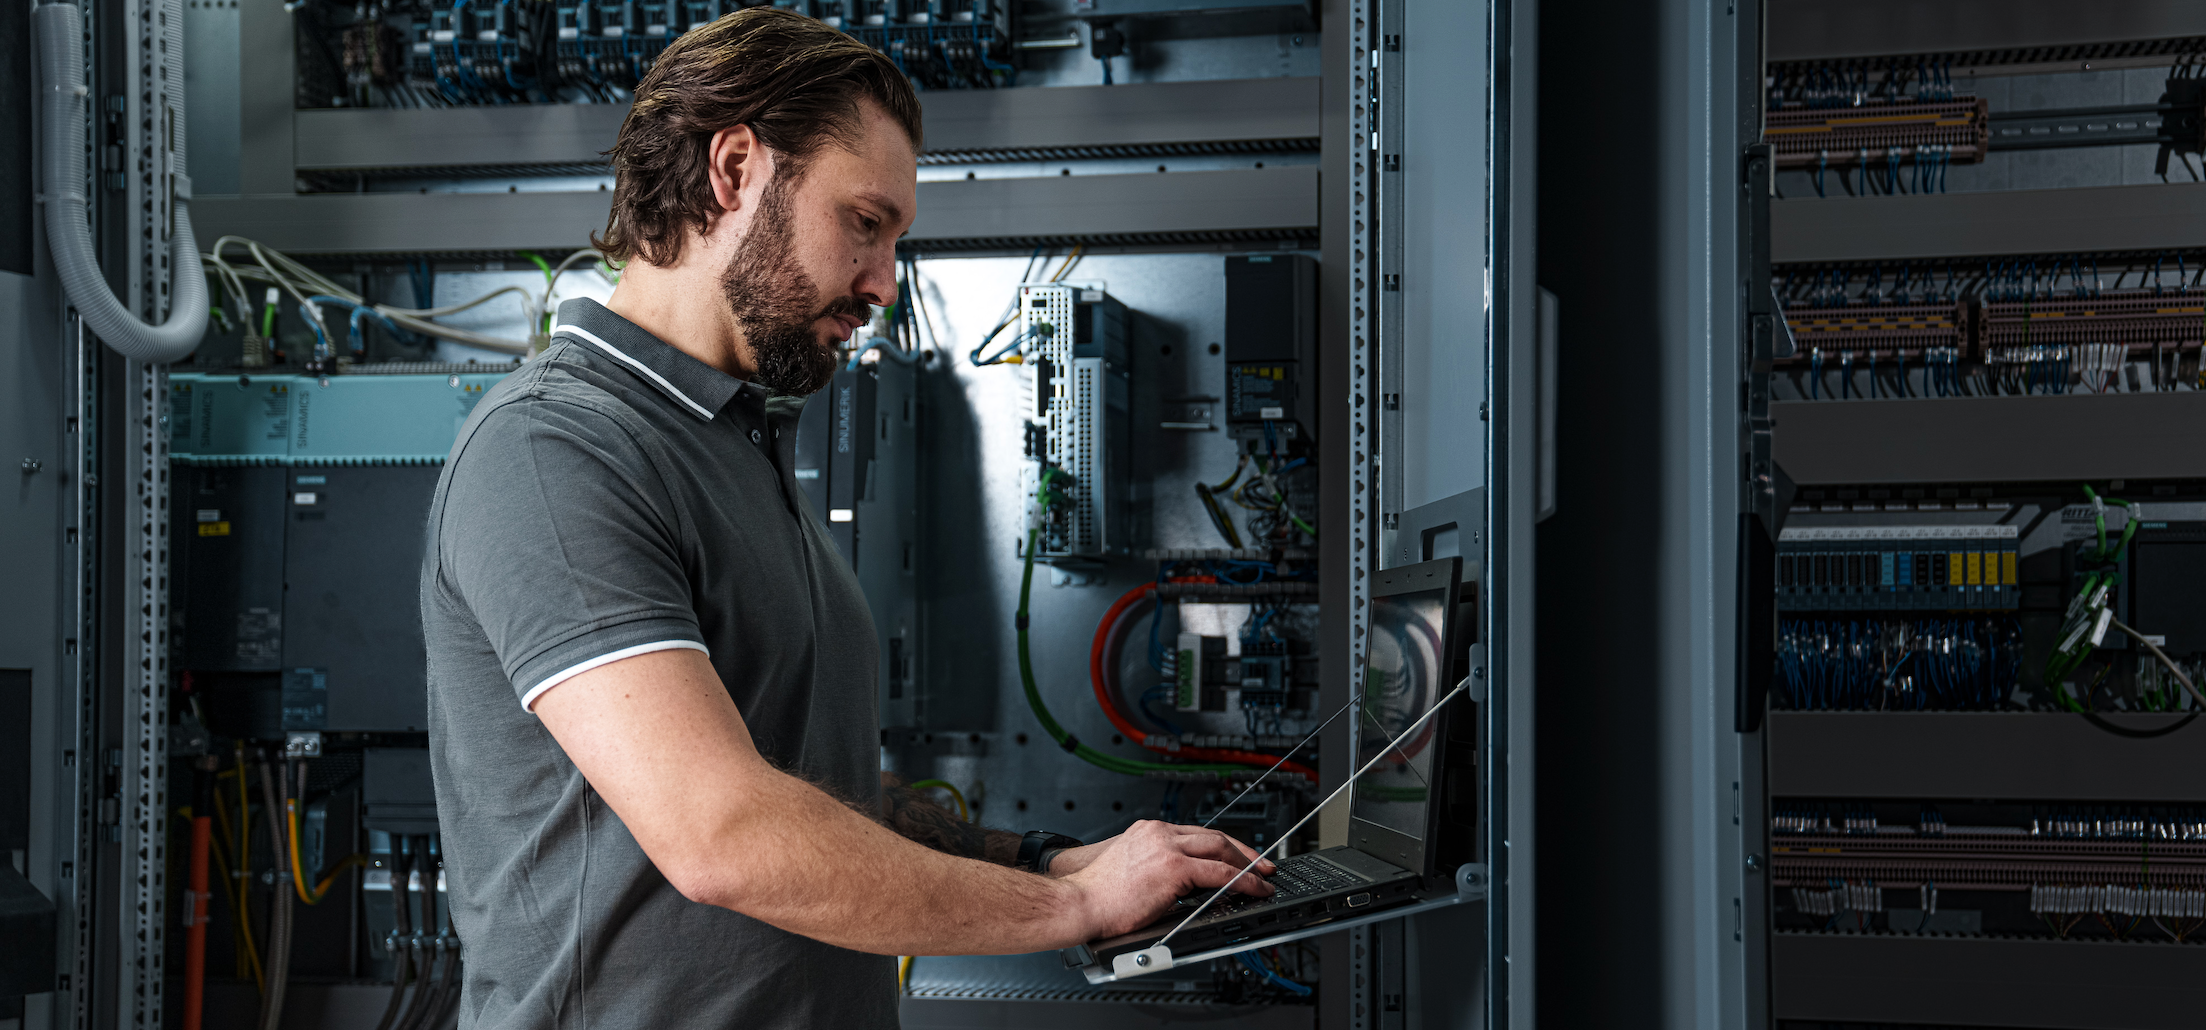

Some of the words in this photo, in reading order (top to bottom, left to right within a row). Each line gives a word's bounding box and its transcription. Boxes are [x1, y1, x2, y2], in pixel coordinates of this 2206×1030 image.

[200, 390, 212, 448] SINAMICS
[297, 390, 309, 448] SINAMICS
[838, 386, 850, 453] SINUMERIK
[1232, 366, 1242, 416] SINAMICS
